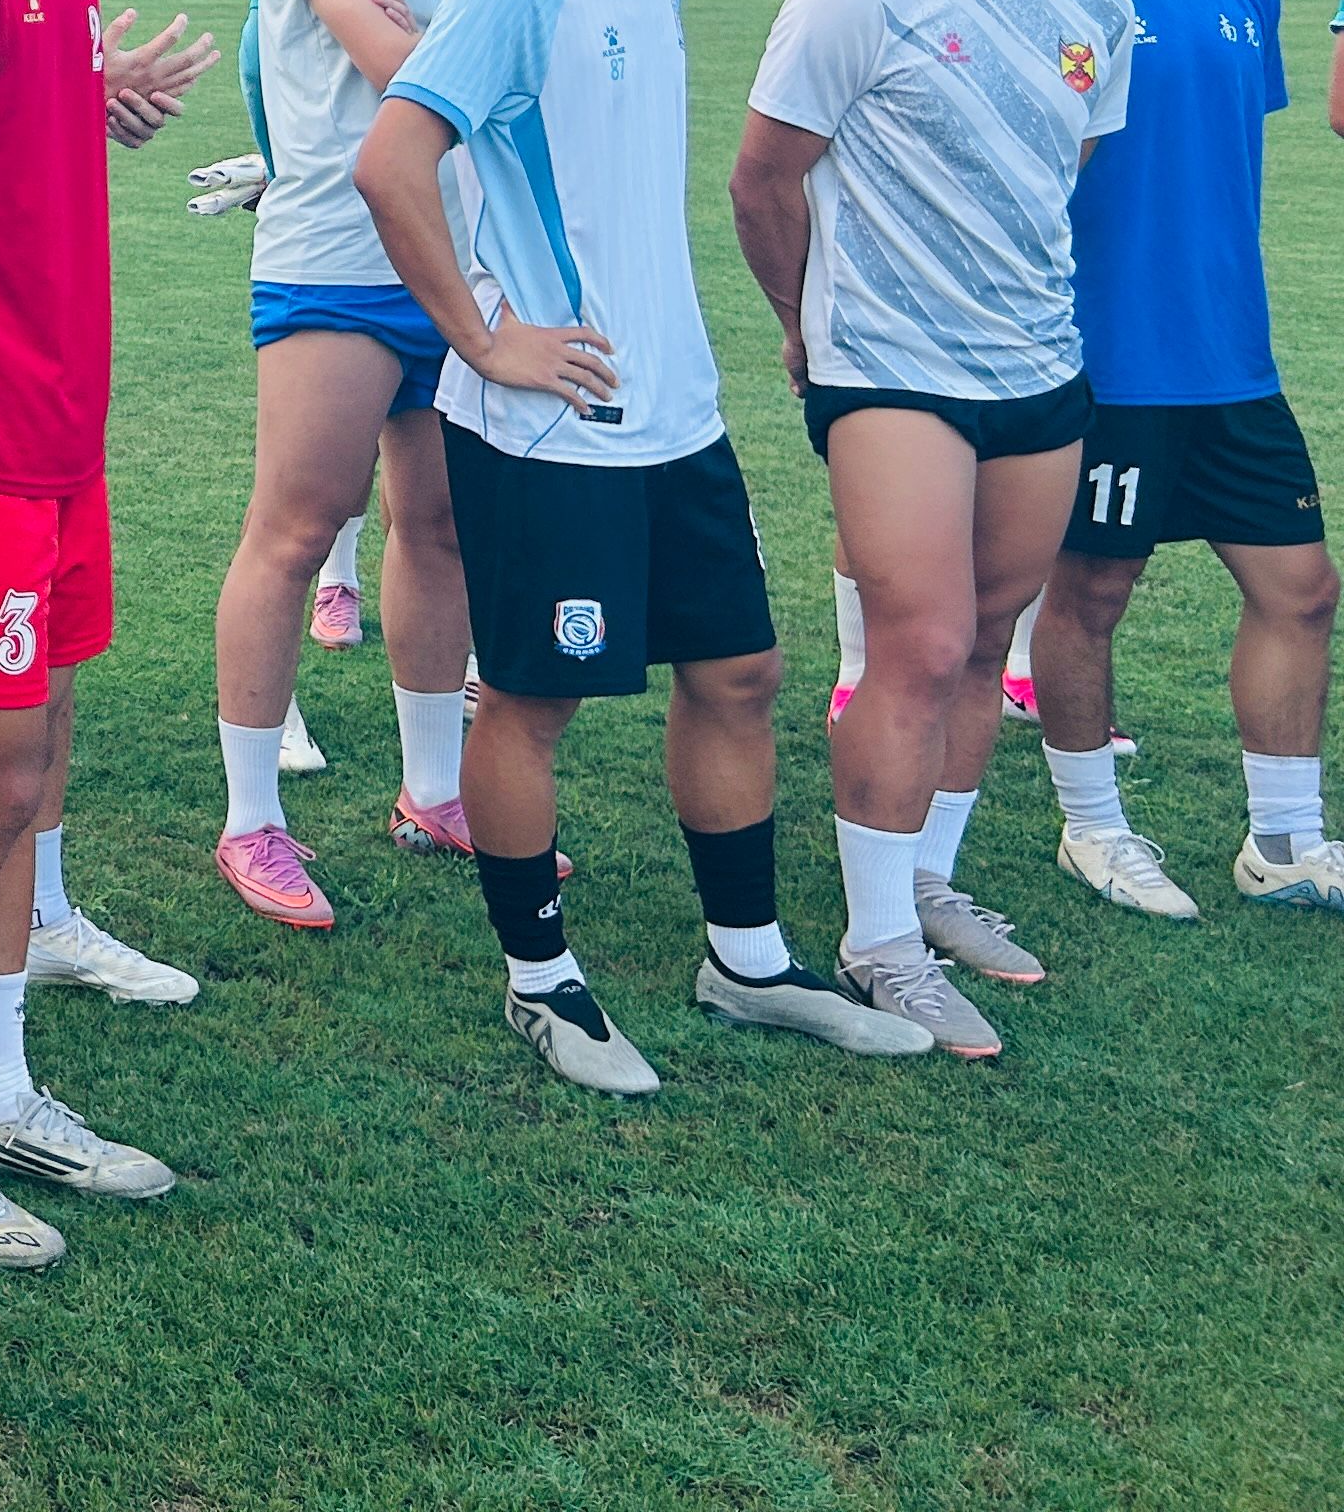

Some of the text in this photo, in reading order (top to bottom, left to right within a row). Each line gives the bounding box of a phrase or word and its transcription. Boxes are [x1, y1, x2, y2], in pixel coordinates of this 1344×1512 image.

[1134, 35, 1157, 44] ELME
[1219, 14, 1259, 47] 南充
[1088, 463, 1141, 526] 11
